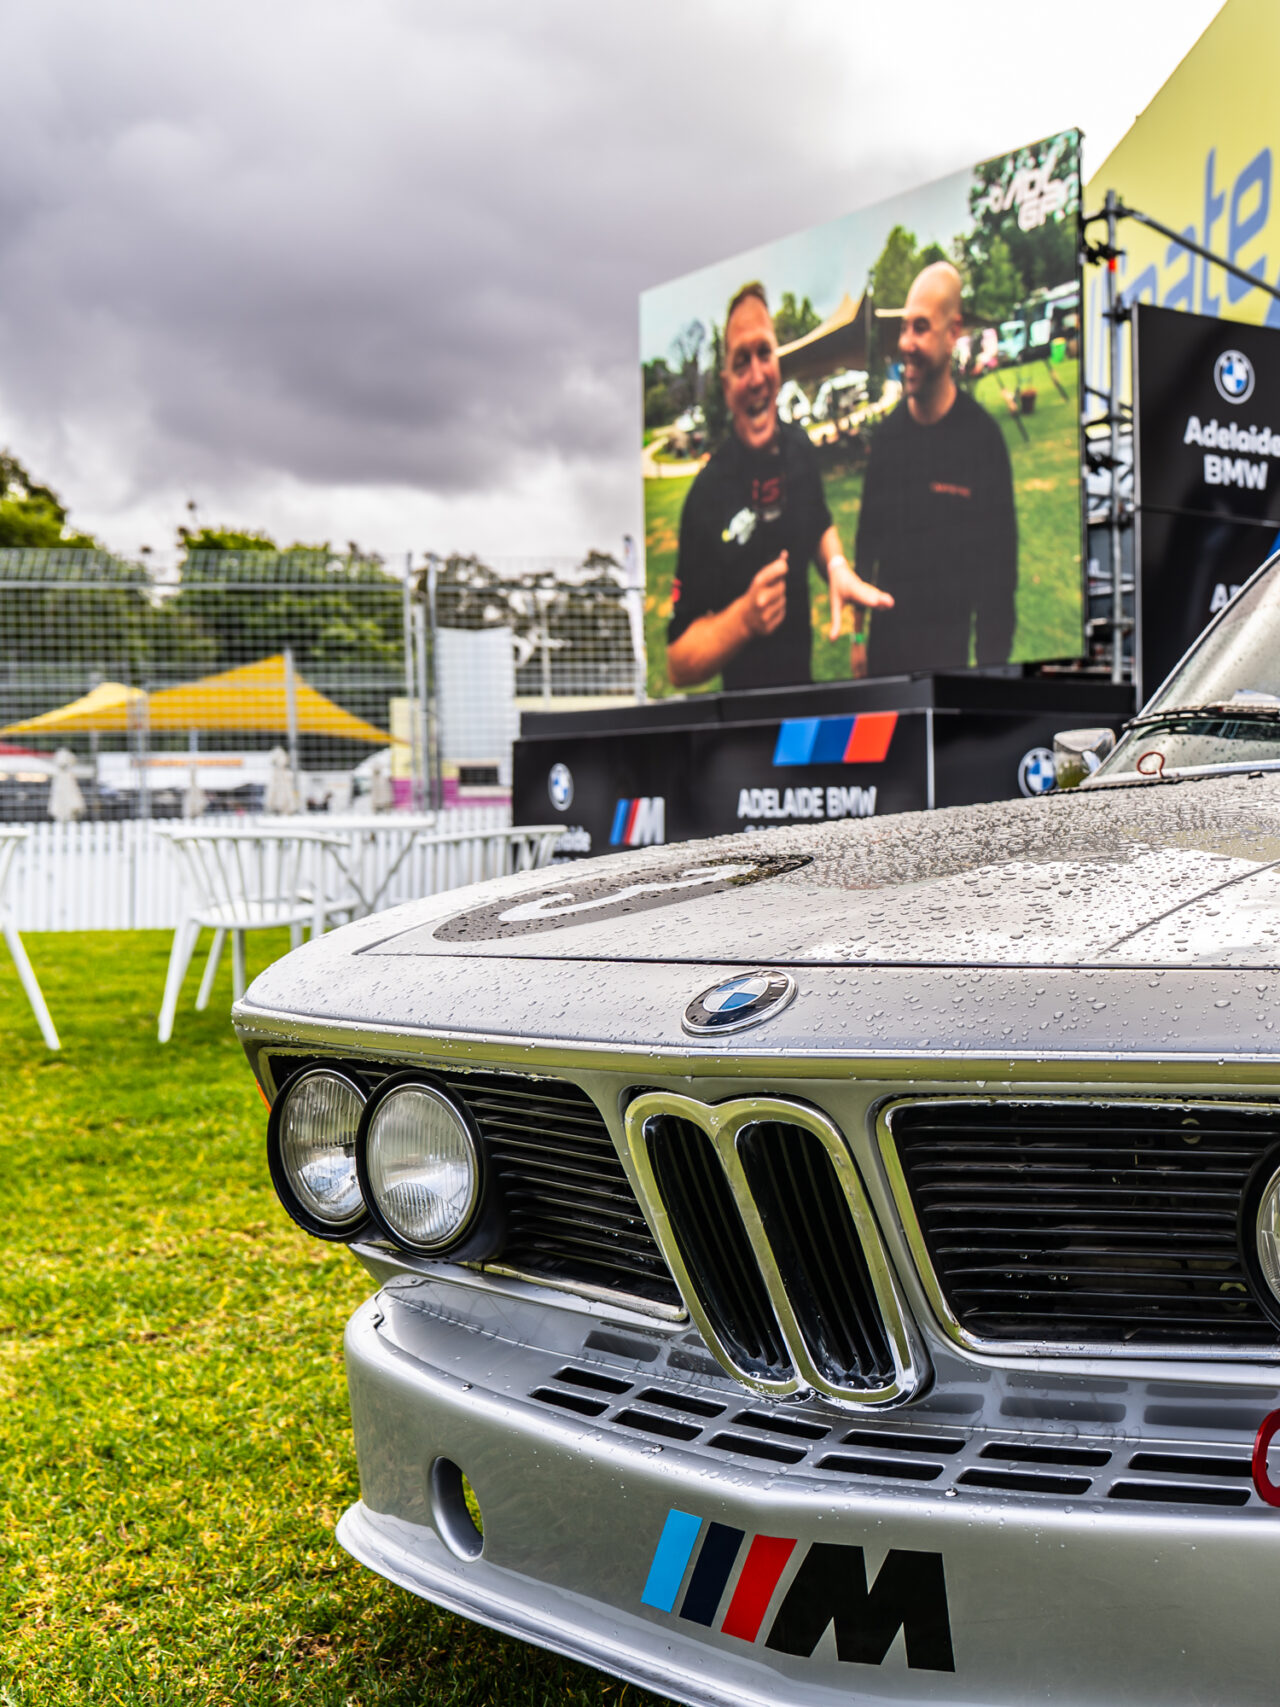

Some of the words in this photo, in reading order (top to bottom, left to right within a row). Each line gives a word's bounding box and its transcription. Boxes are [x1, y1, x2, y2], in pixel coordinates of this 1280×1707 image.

[1203, 453, 1268, 490] BMW
[737, 787, 825, 819] ADELAIDE
[826, 785, 877, 818] BMW
